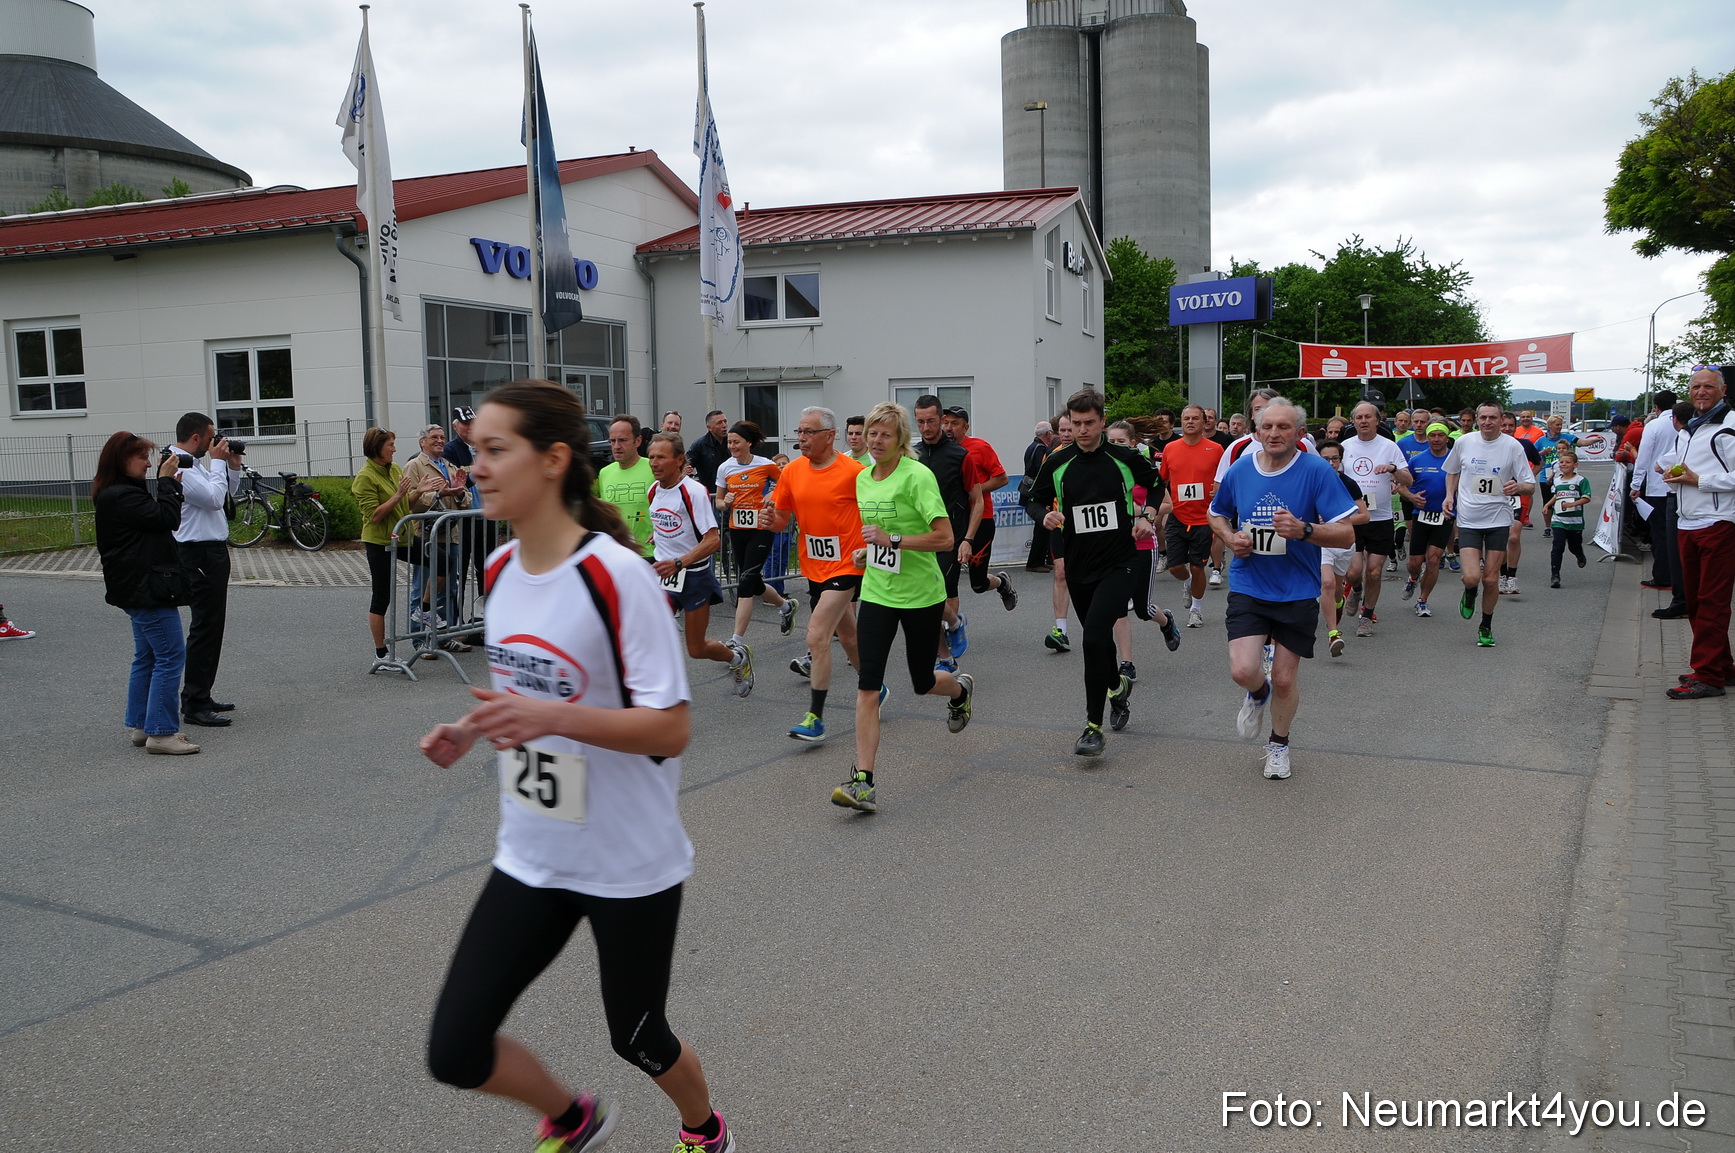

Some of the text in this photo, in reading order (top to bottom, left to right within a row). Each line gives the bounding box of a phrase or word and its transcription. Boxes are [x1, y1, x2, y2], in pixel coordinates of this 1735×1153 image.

[469, 237, 599, 291] VOO
[1176, 290, 1242, 312] VOLVO
[1184, 484, 1197, 499] 41
[1478, 478, 1493, 494] 31
[736, 510, 754, 525] 133
[1081, 505, 1109, 529] 116
[1424, 511, 1441, 524] 148
[809, 538, 835, 558] 105
[1250, 527, 1276, 552] 117
[872, 542, 897, 568] 125
[513, 745, 558, 809] 25
